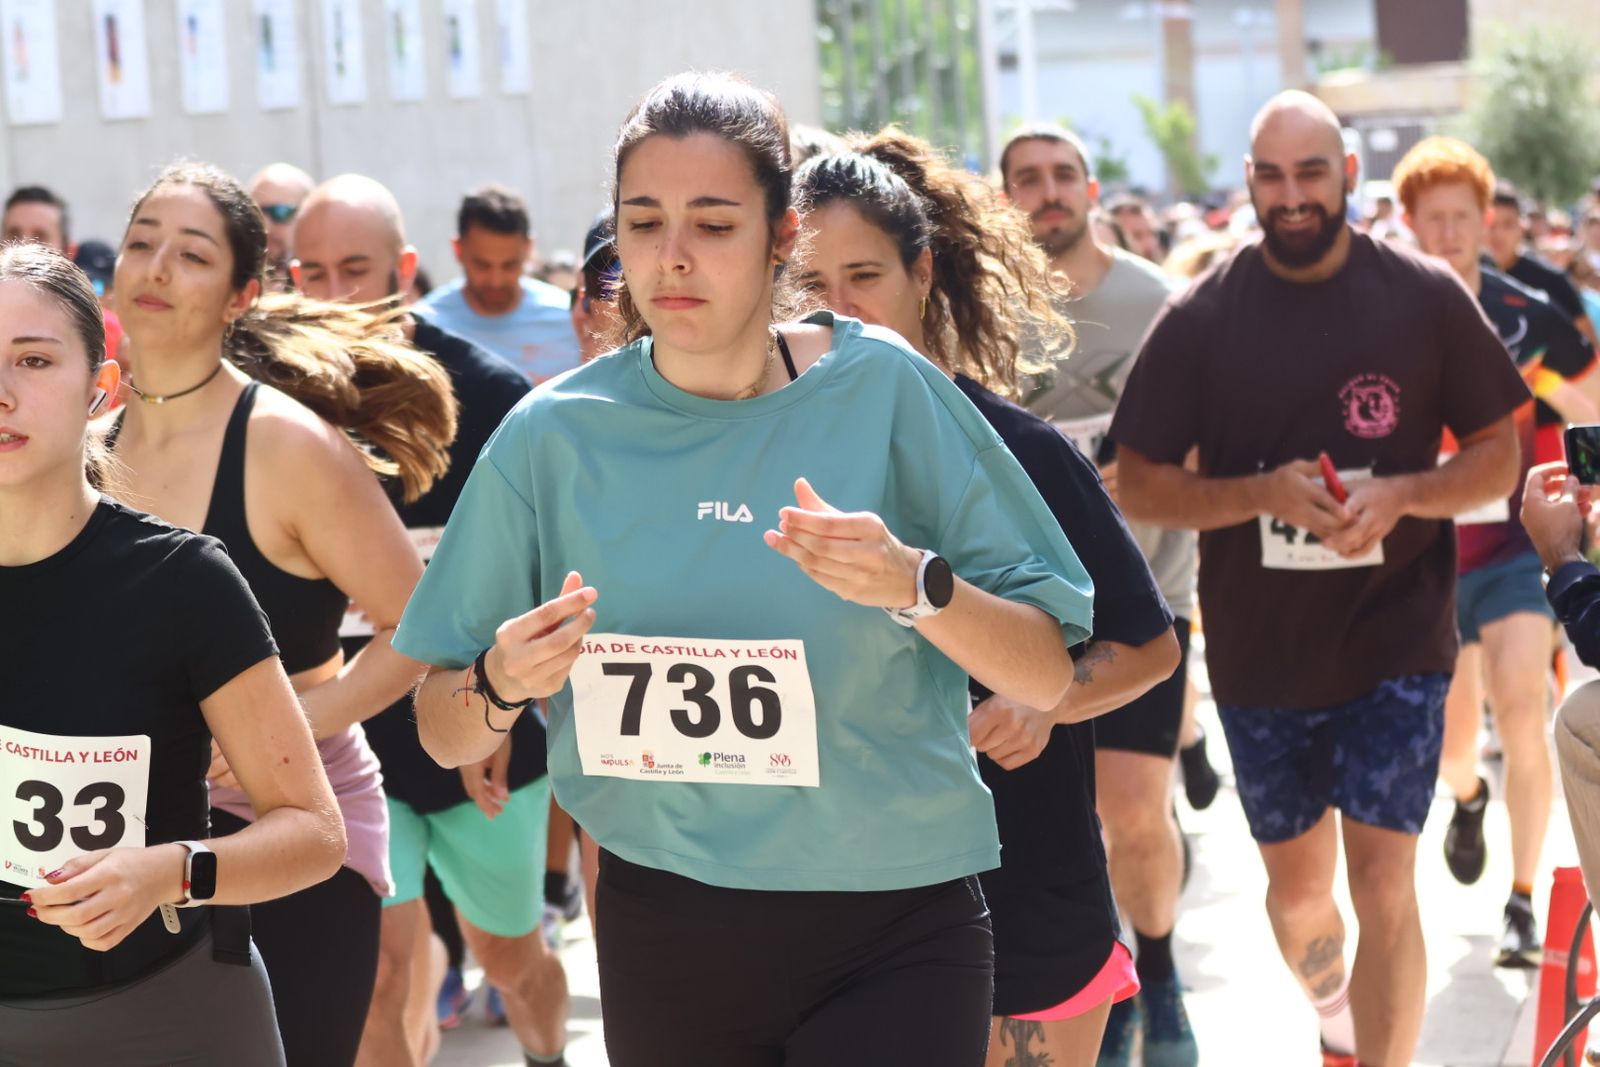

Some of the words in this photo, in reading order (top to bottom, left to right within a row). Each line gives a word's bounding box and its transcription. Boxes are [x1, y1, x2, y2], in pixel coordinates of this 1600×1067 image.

[697, 501, 754, 523] FILA
[610, 643, 636, 653] DE
[641, 644, 726, 658] CASTILLA
[730, 649, 741, 658] Y
[747, 646, 797, 660] LEÓN
[601, 662, 782, 740] 736
[5, 741, 75, 763] CASTILLA
[79, 751, 90, 763] Y
[93, 747, 138, 763] LEÓN
[713, 752, 746, 762] Plena
[12, 780, 126, 853] 33
